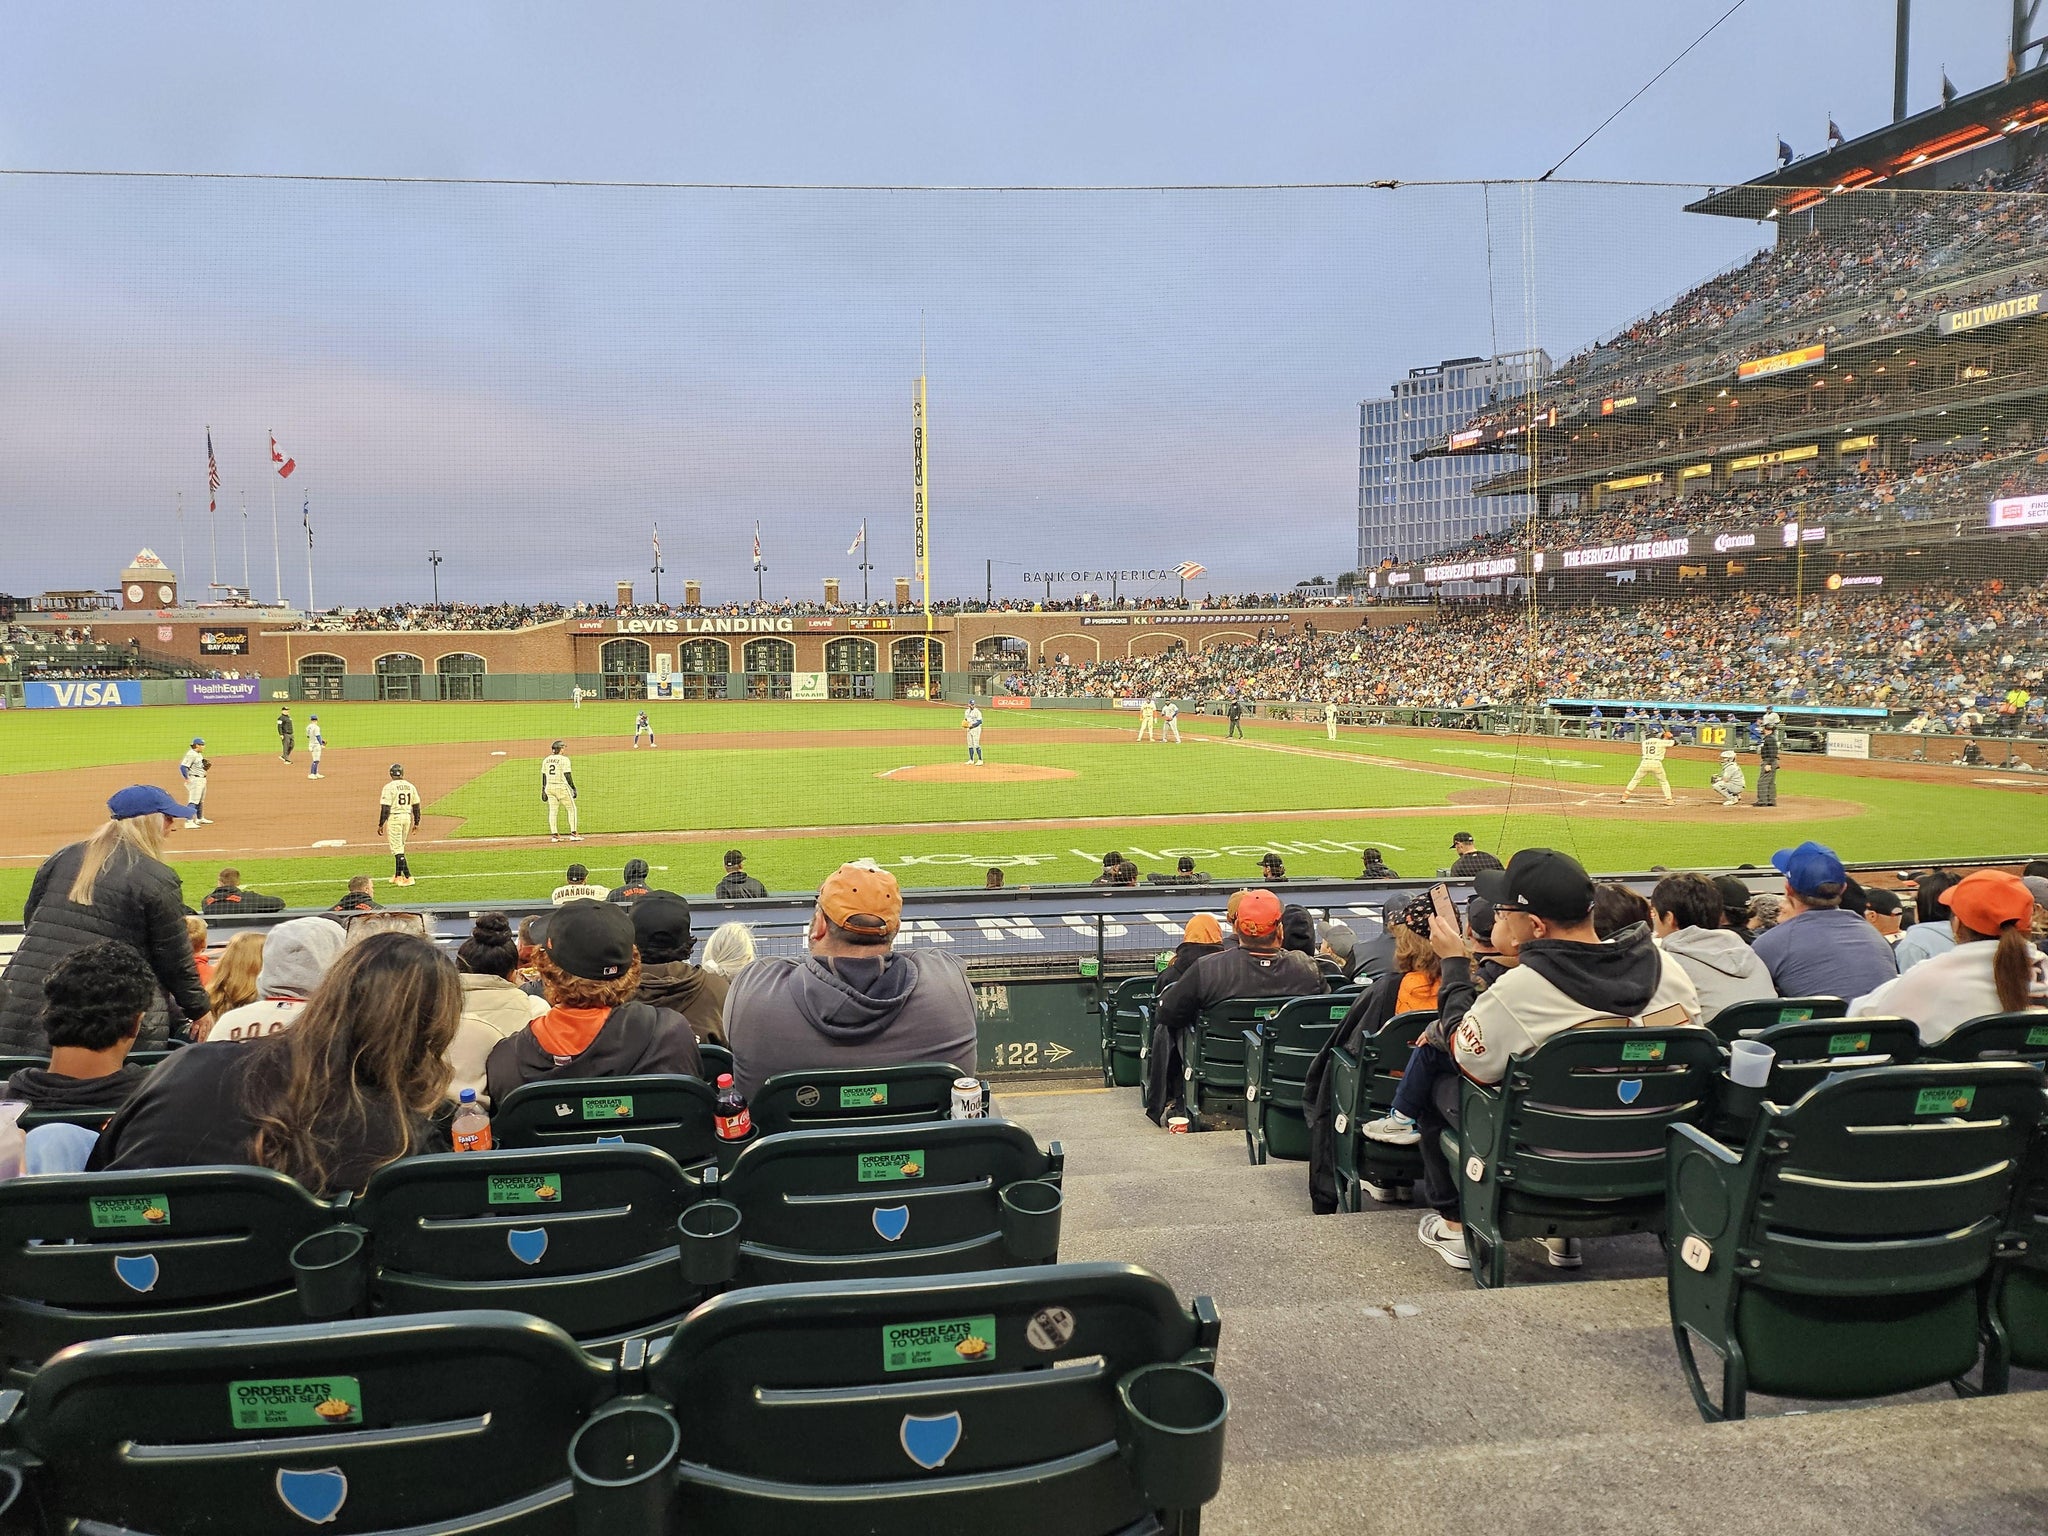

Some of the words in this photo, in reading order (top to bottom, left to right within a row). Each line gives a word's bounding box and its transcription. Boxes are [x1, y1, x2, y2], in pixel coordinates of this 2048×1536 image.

[1952, 294, 2039, 330] CUTWATER
[1613, 396, 1637, 408] TOYOTA
[1714, 533, 1756, 552] Corona
[1563, 550, 1581, 568] THE
[1581, 545, 1619, 566] CERVEZA
[1620, 544, 1633, 562] OF
[1633, 541, 1652, 560] THE
[1652, 537, 1689, 559] GIANTS
[1424, 567, 1438, 580] THE
[1437, 563, 1465, 580] CERVEZA
[1465, 562, 1476, 577] OF
[1476, 560, 1489, 576] THE
[1489, 557, 1516, 575] GIANTS
[1023, 572, 1065, 583] BANK
[1071, 571, 1090, 582] OF
[1094, 569, 1168, 581] AMERICA
[686, 617, 794, 633] LANDING
[215, 632, 248, 645] Sports
[193, 683, 255, 694] HealthEquity
[580, 689, 598, 698] 365
[907, 689, 925, 698] 309
[48, 683, 122, 707] VISA
[272, 691, 289, 699] 415
[1645, 746, 1656, 755] 18
[549, 764, 556, 775] 2
[398, 793, 411, 806] 81
[1067, 839, 1406, 864] Health
[554, 888, 595, 900] CAVANAUGH
[994, 1042, 1038, 1066] 122
[457, 1134, 479, 1143] FANTA
[890, 1153, 910, 1161] EATS
[492, 1177, 524, 1185] ORDER
[524, 1176, 545, 1184] EATS
[95, 1199, 130, 1207] ORDER
[129, 1198, 153, 1206] EATS
[889, 1326, 937, 1340] ORDER
[938, 1322, 971, 1336] EATS
[891, 1338, 907, 1348] TO
[910, 1335, 942, 1347] YOUR
[236, 1385, 293, 1397] ORDER
[293, 1383, 332, 1395] EATS
[239, 1396, 258, 1406] TO
[261, 1395, 297, 1405] YOUR
[265, 1415, 288, 1423] Eats
